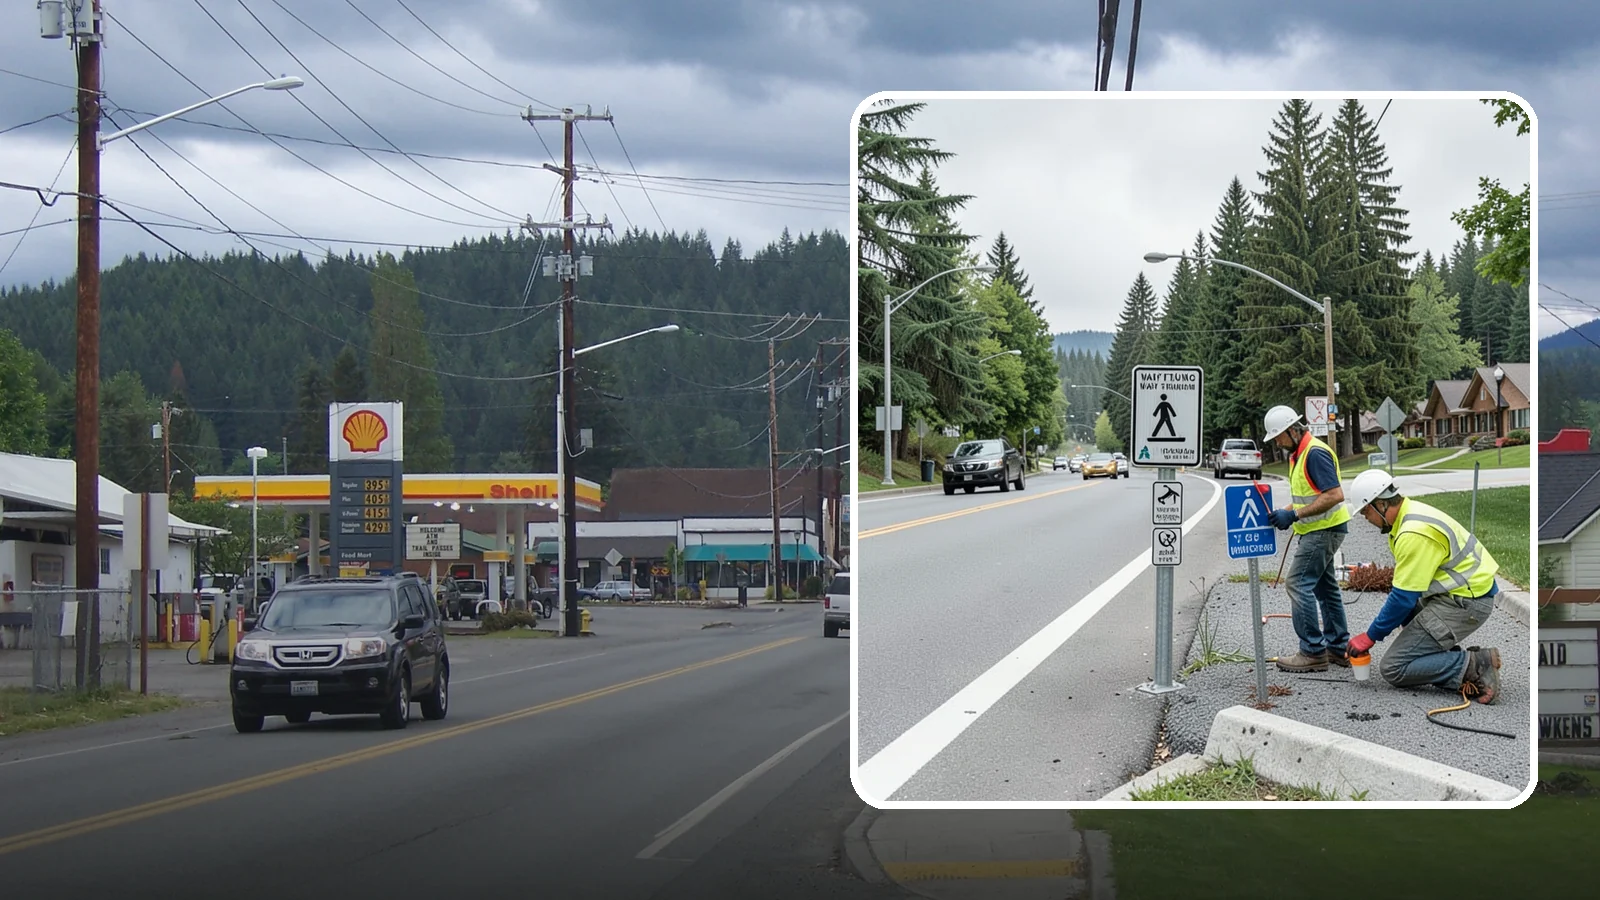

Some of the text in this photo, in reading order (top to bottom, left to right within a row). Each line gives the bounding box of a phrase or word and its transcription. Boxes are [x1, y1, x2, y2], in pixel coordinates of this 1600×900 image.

[366, 480, 383, 490] 395
[490, 484, 547, 499] Shell
[366, 494, 383, 504] 405
[366, 508, 383, 518] 415
[366, 522, 383, 532] 429
